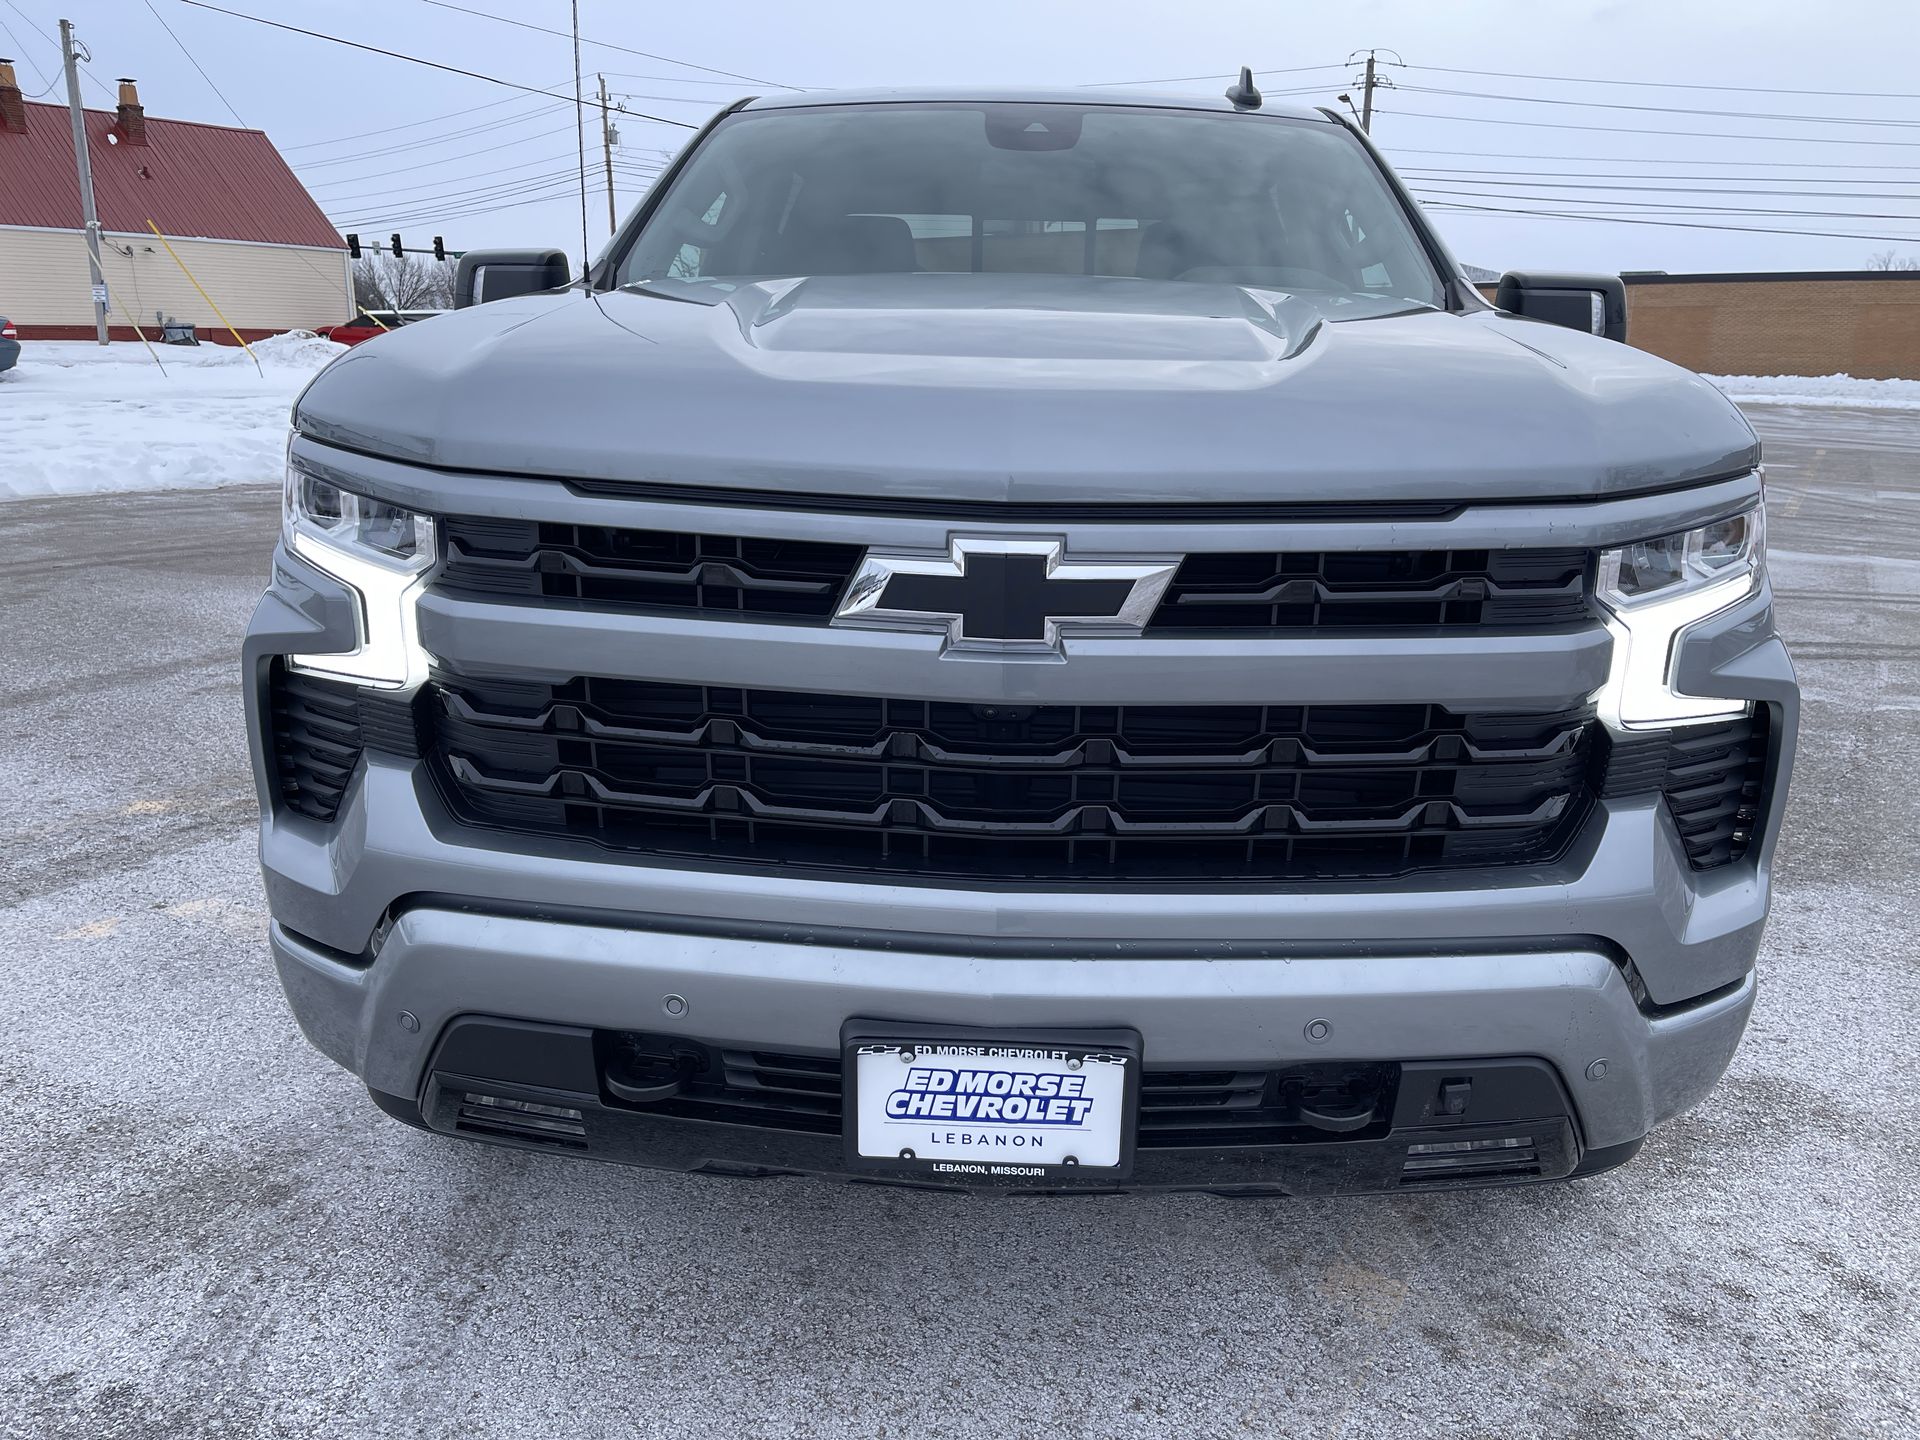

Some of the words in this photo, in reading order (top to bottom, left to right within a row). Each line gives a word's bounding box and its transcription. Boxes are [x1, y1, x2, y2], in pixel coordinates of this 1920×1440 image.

[914, 1045, 932, 1055] ED
[936, 1046, 985, 1057] MORSE
[988, 1047, 1069, 1061] CHEVROLET
[904, 1068, 955, 1092] ED
[955, 1071, 1085, 1098] MORSE
[886, 1091, 1093, 1123] CHEVROLET
[931, 1132, 1043, 1147] LEBANON
[933, 1163, 988, 1175] LEBANON,
[991, 1166, 1045, 1176] MISSOURI
